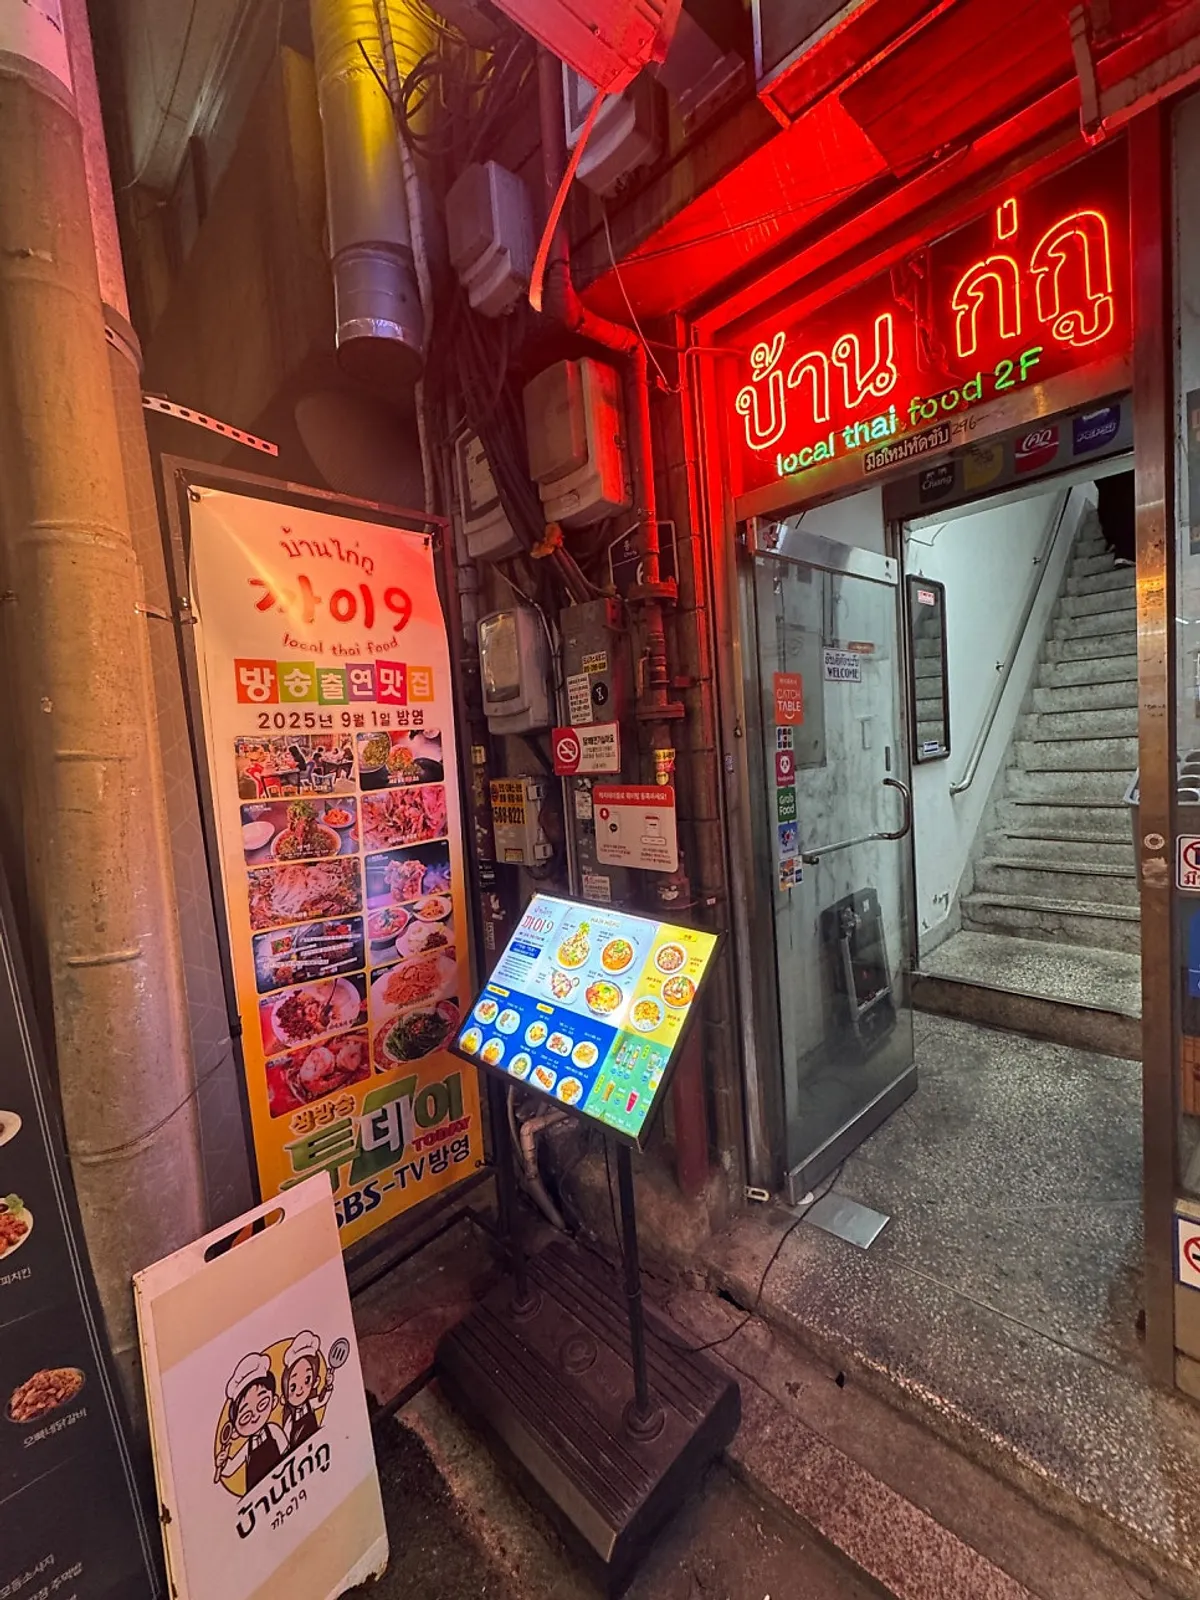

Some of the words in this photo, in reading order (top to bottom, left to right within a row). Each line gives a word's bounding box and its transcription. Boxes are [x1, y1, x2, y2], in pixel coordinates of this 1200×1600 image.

[777, 435, 836, 476] local
[843, 405, 897, 449] thai
[907, 375, 984, 426] food
[994, 346, 1043, 391] 2F
[283, 633, 323, 655] local
[332, 645, 361, 656] thai
[368, 635, 399, 654] food
[777, 700, 801, 711] TABLE
[258, 712, 333, 729] 2025년
[341, 711, 365, 727] 9월
[372, 710, 391, 727] 1일
[397, 709, 425, 727] 방영
[780, 805, 795, 817] Food
[291, 1095, 356, 1135] 생방송
